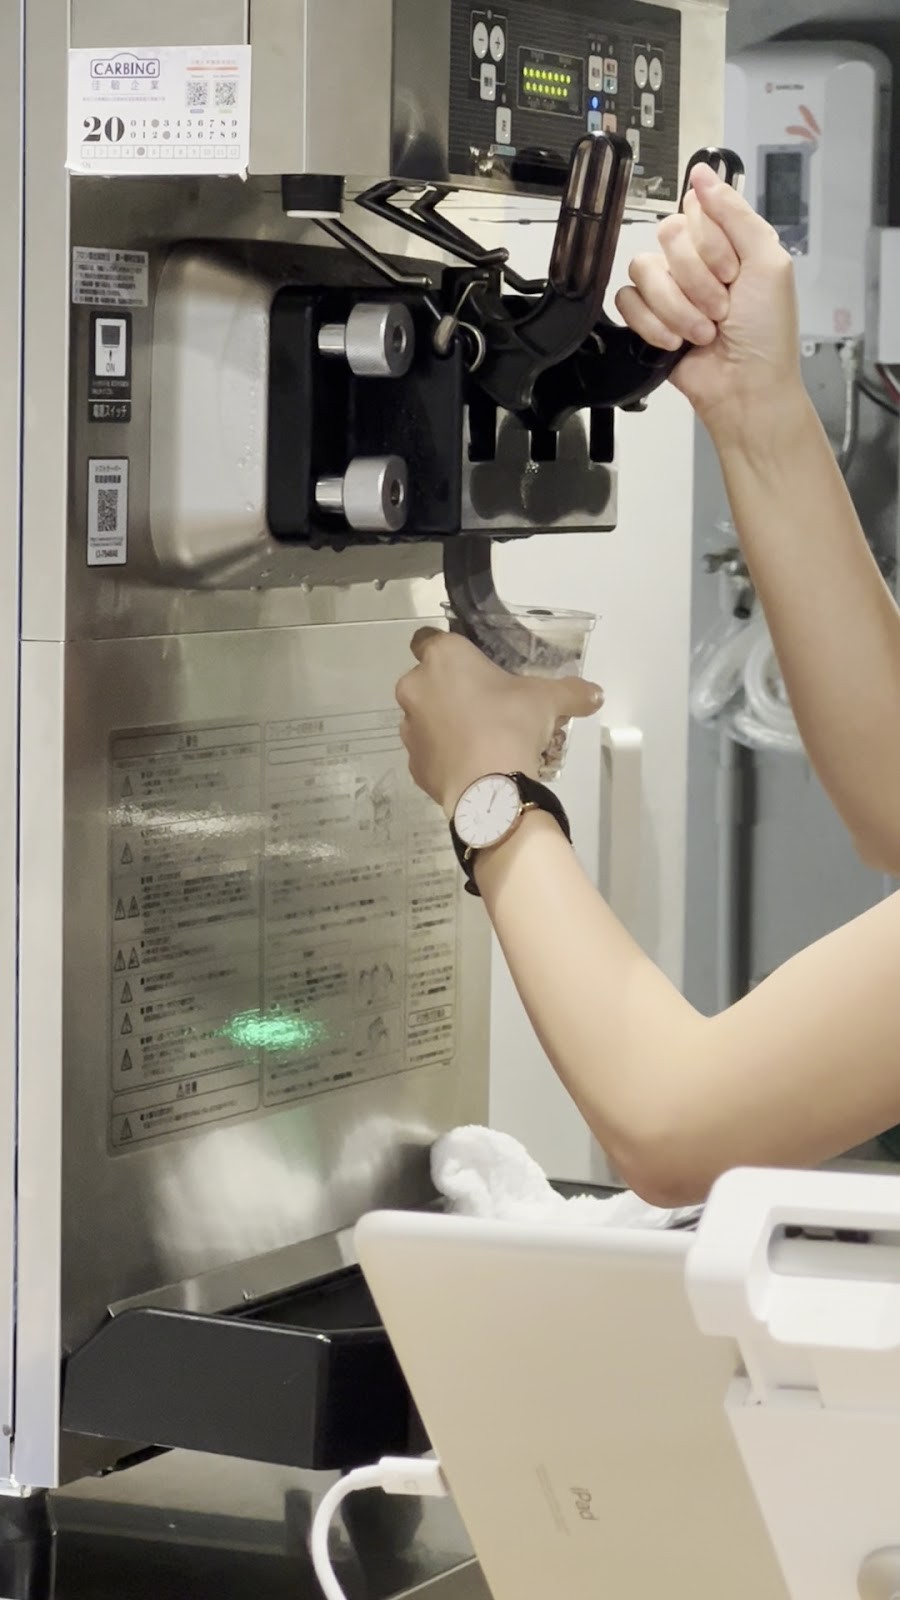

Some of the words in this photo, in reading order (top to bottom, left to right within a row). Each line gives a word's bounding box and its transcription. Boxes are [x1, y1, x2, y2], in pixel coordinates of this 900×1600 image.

[94, 62, 156, 75] CARBING
[83, 116, 125, 142] 20
[570, 1487, 599, 1521] iPad
